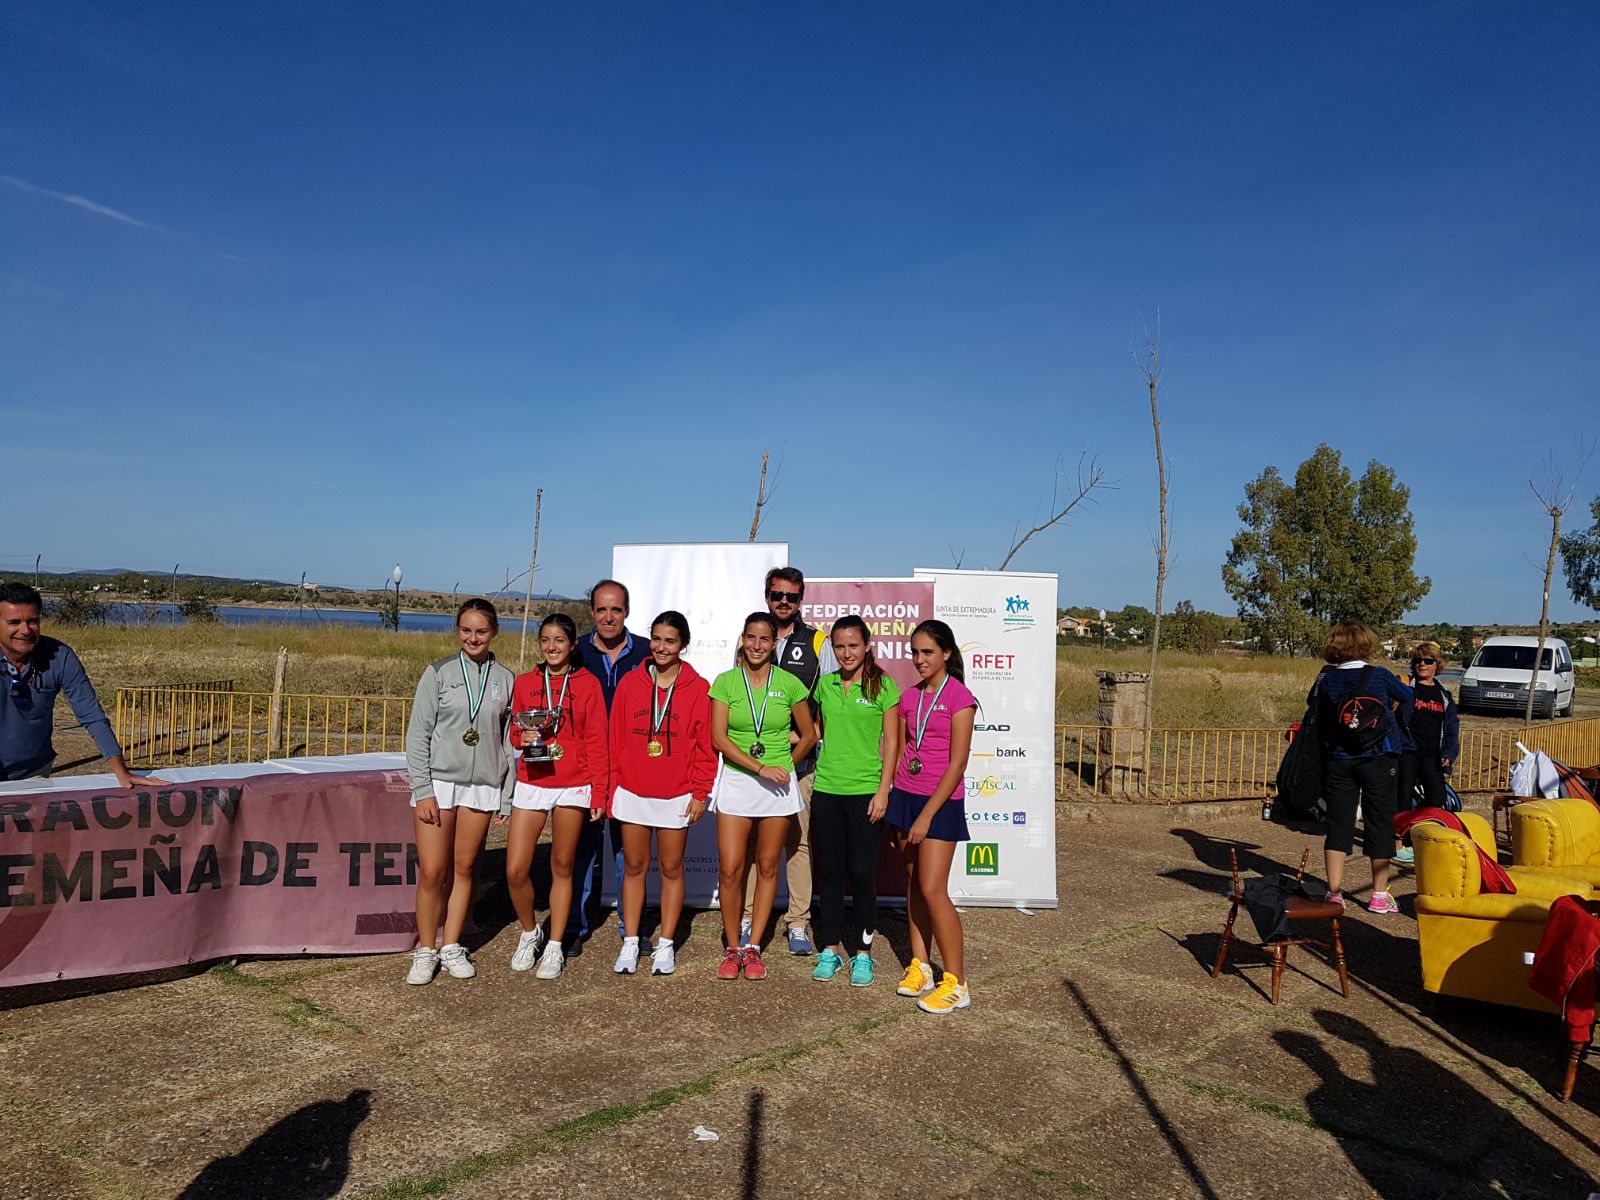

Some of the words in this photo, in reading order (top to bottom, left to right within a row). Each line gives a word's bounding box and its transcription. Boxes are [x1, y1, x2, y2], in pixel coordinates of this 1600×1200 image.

[801, 601, 920, 618] FEDERACIÓN
[972, 654, 1016, 669] RFET
[974, 724, 1011, 732] EAD
[996, 746, 1026, 758] bank
[965, 812, 1010, 821] otes
[239, 841, 319, 887] DE
